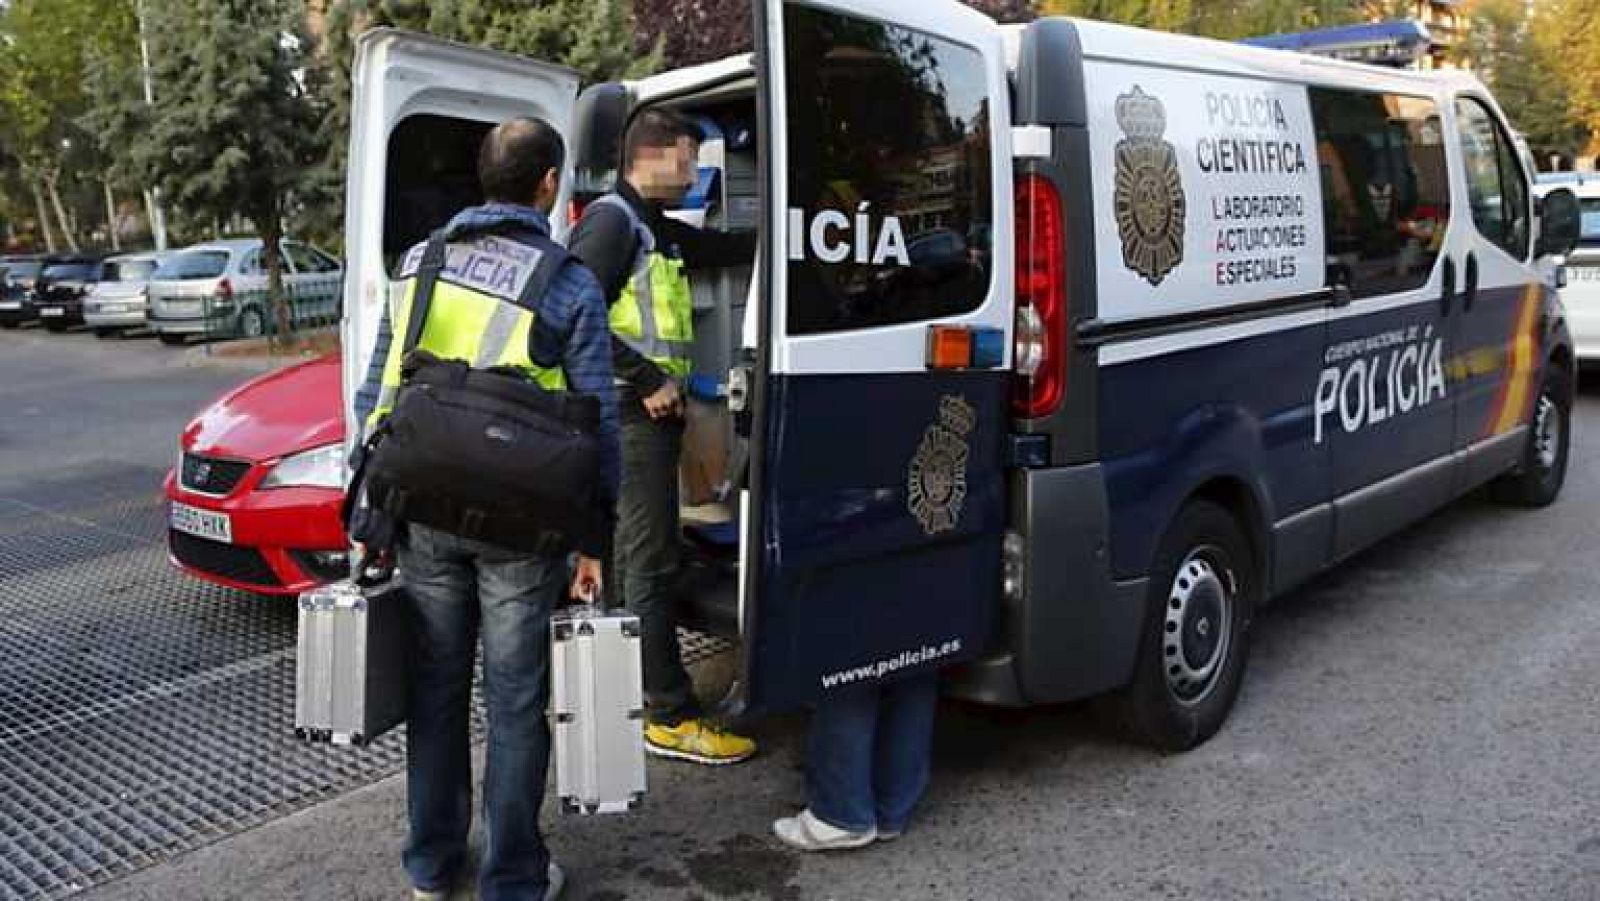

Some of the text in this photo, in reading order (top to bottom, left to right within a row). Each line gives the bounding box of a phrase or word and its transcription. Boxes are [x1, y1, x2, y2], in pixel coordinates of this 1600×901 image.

[1212, 193, 1305, 219] LABORATORIO
[1216, 224, 1306, 252] ACTUACIONES
[1216, 256, 1297, 285] ESPECIALES
[1314, 322, 1446, 445] POLICÍA
